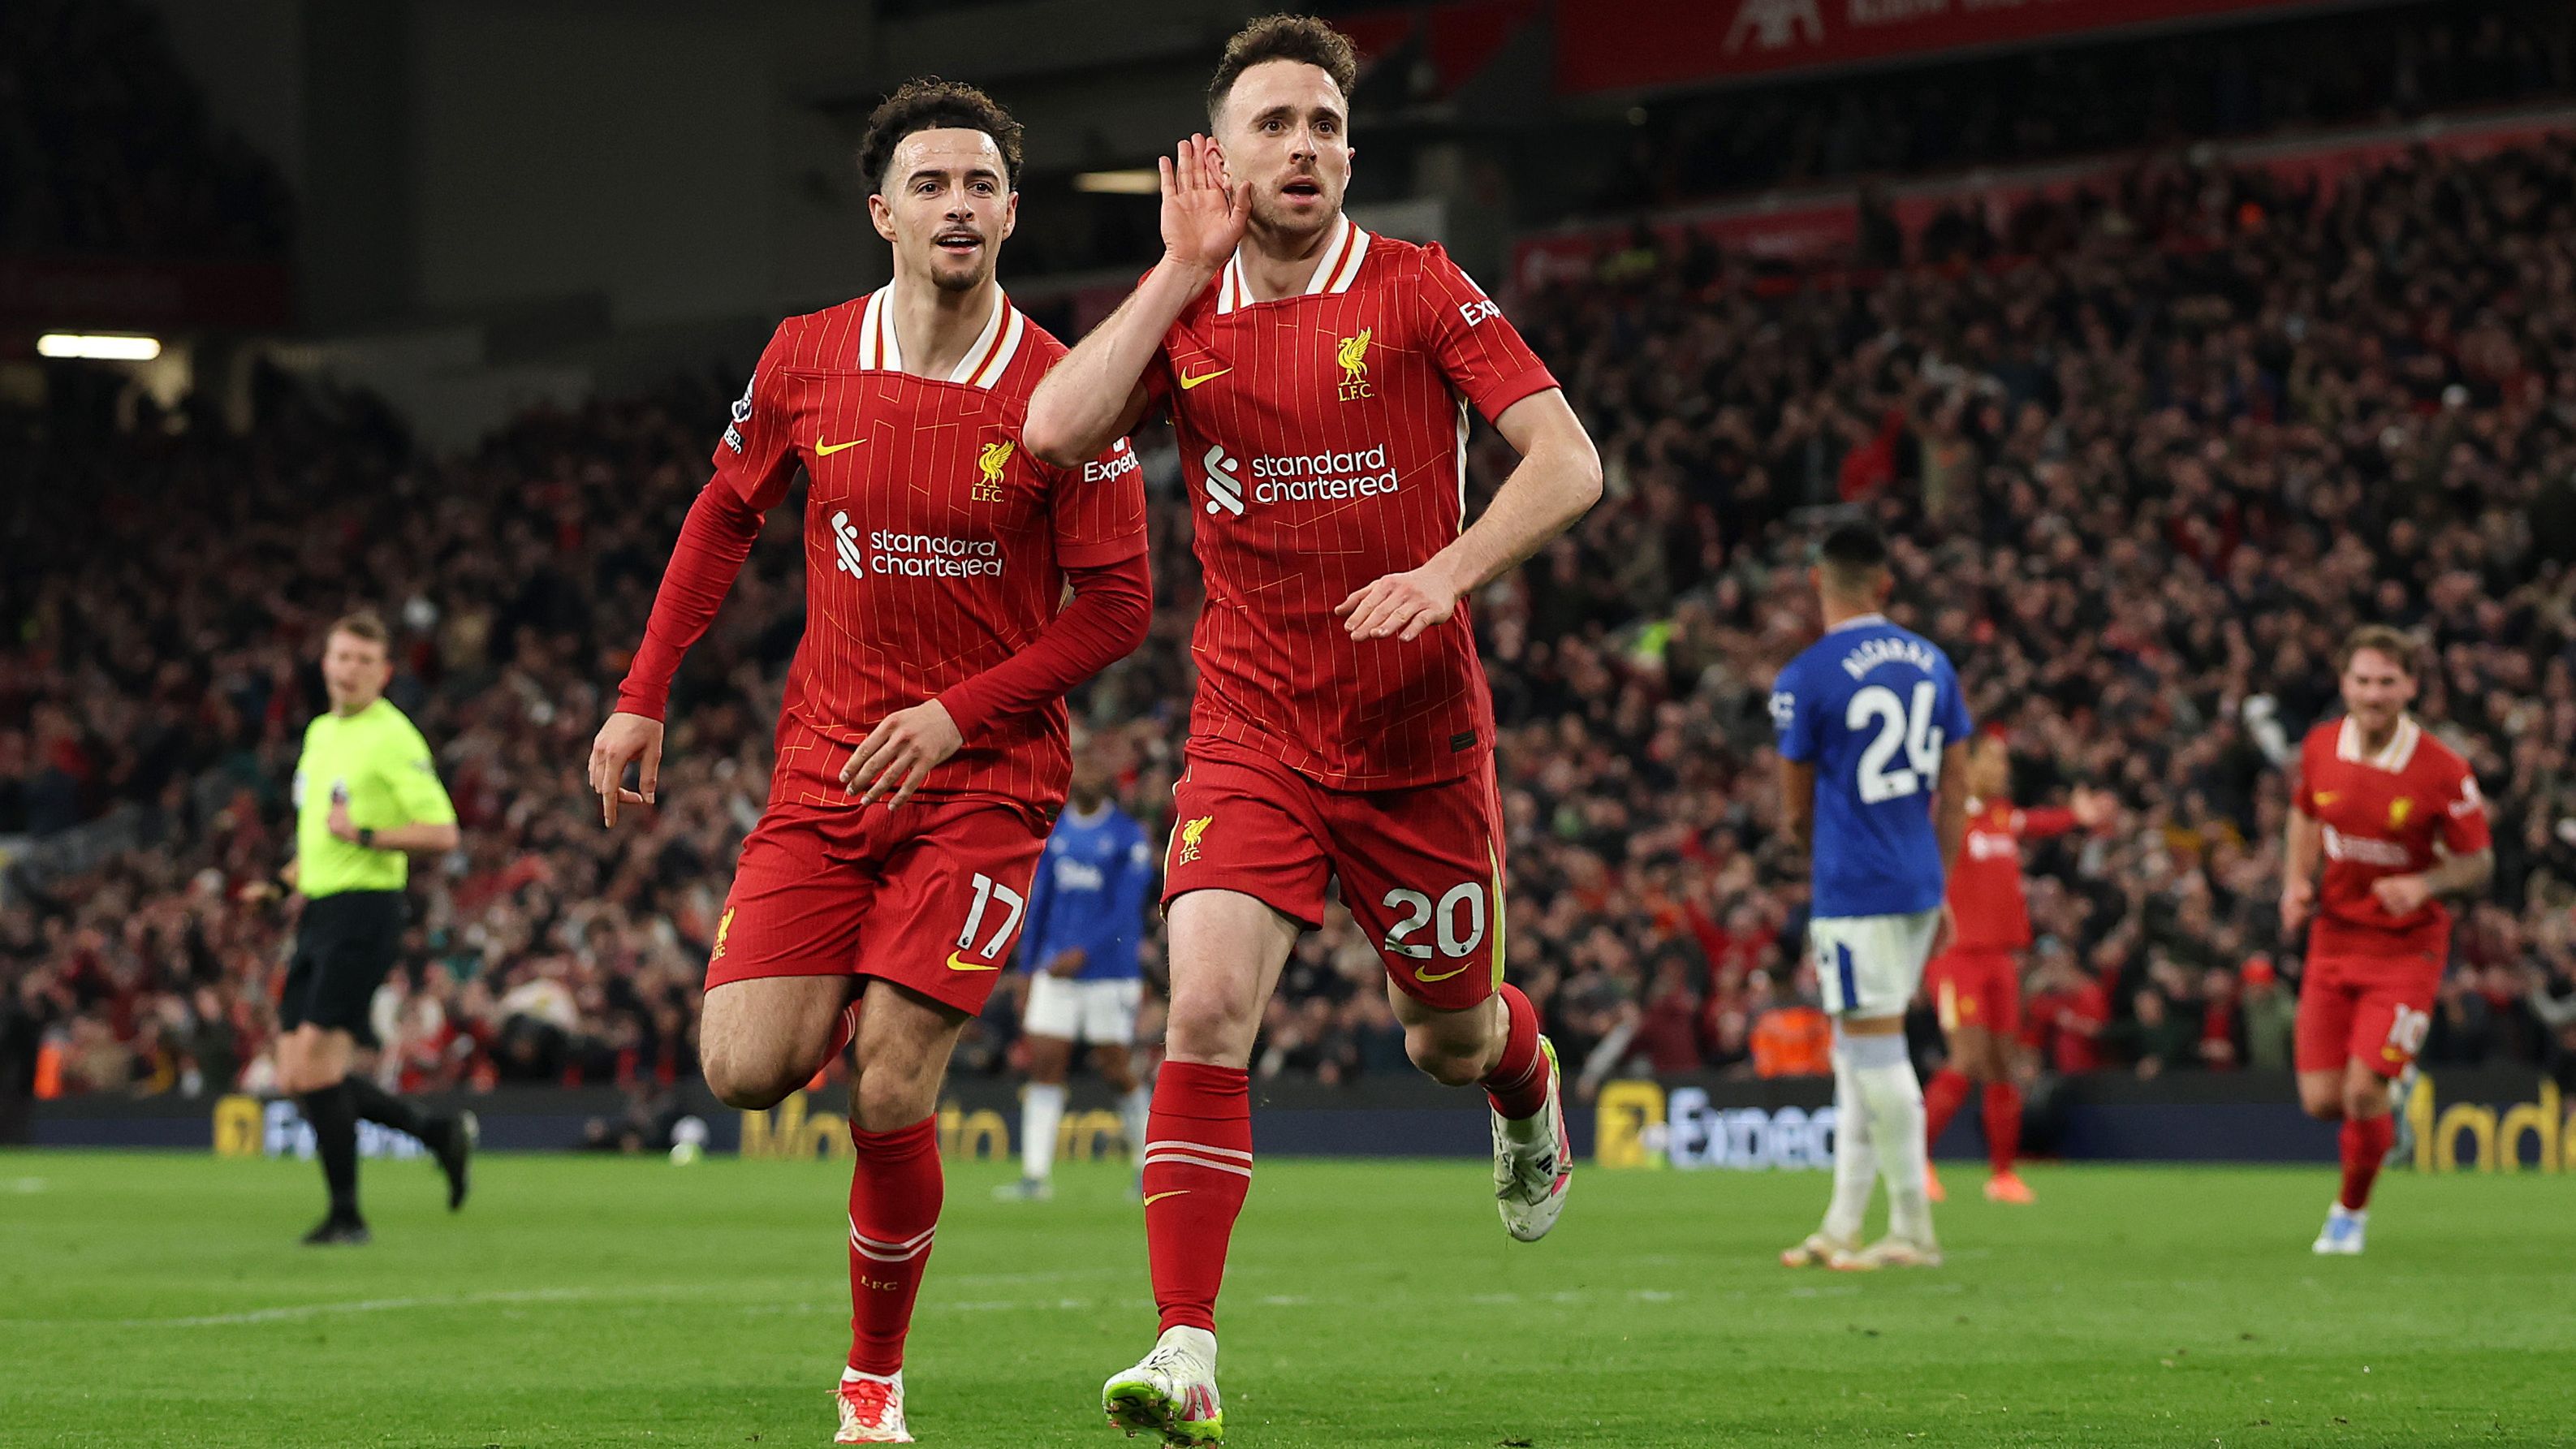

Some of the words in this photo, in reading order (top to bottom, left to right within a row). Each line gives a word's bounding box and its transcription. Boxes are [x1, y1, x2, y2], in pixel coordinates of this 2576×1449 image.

[1252, 443, 1387, 477] standard
[1255, 468, 1399, 503] chartered
[870, 529, 997, 557] standard
[871, 554, 1003, 578] chartered
[1845, 680, 1944, 805] 24
[956, 872, 1024, 960] 17
[1382, 882, 1485, 960] 20
